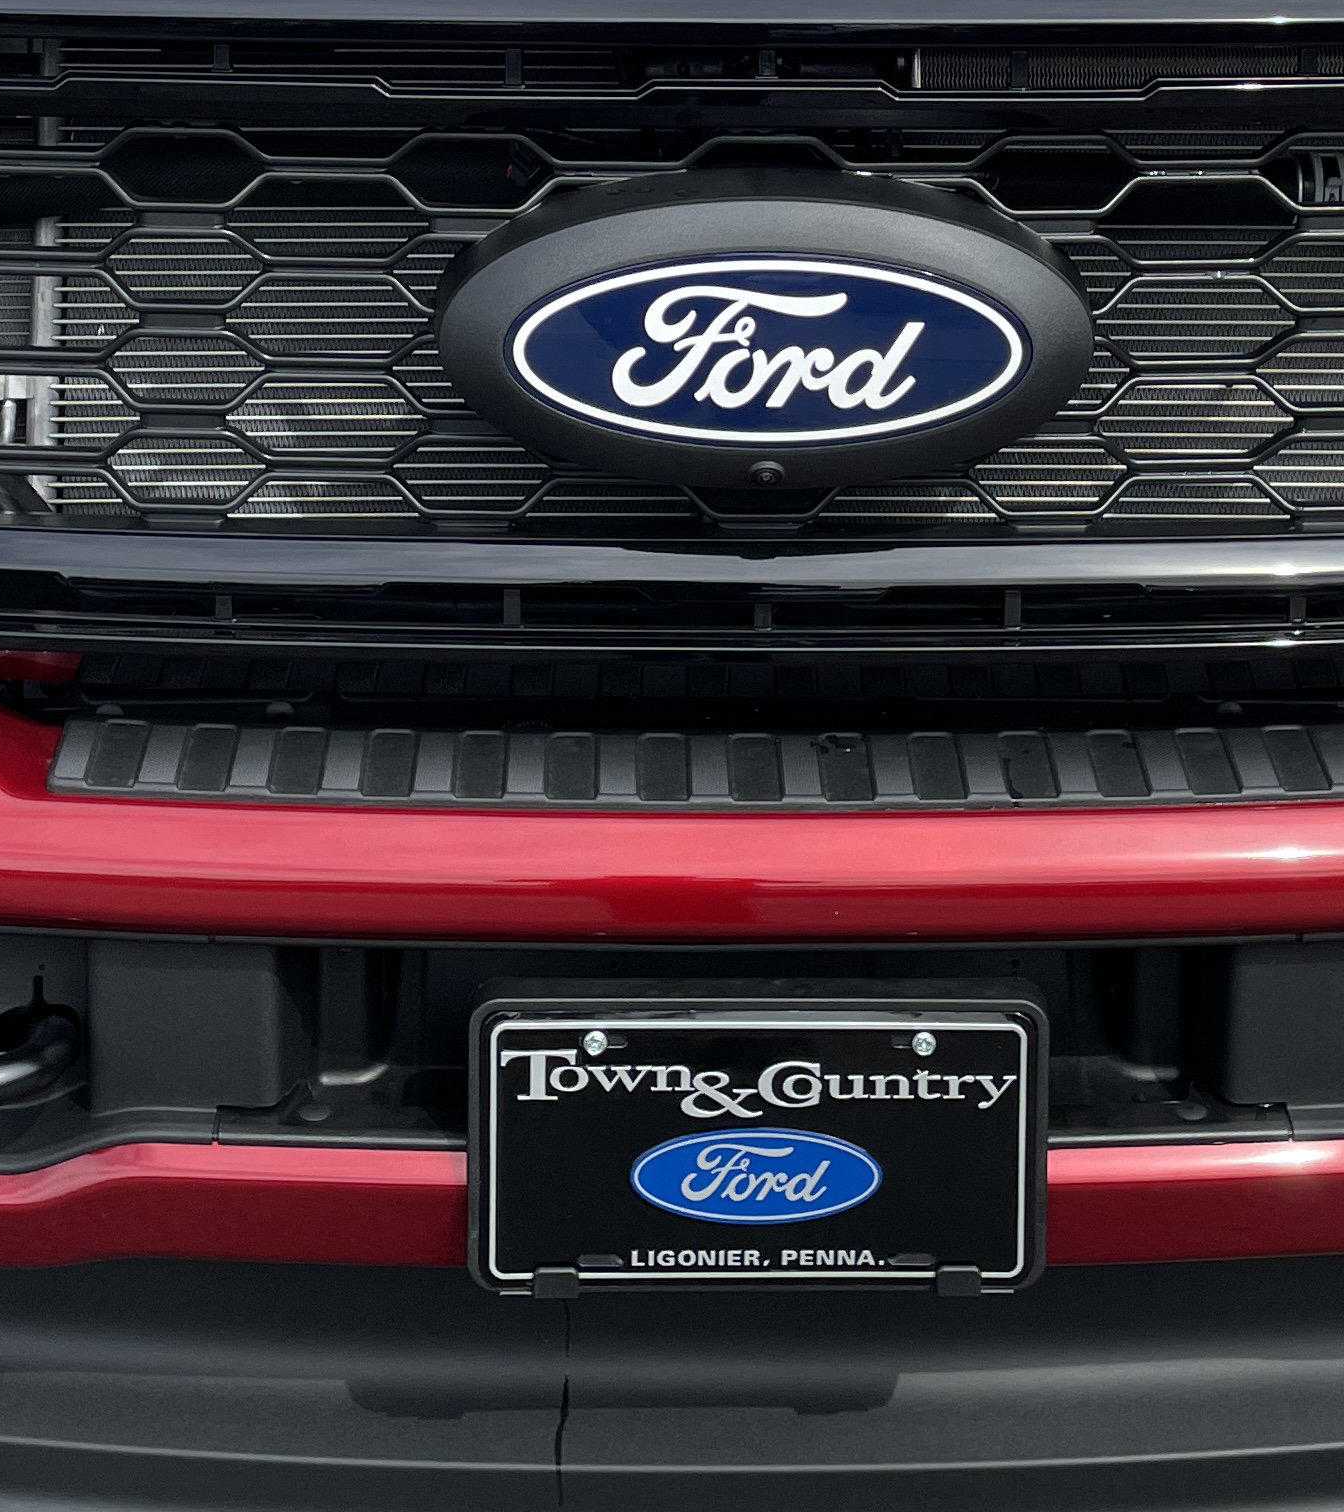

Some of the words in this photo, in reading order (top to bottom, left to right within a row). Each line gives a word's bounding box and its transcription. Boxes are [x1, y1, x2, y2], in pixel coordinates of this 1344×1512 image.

[612, 285, 925, 409] Ford
[681, 1144, 830, 1202] Ford
[631, 1249, 770, 1268] LIGONIER,
[782, 1249, 885, 1267] PENNA.
